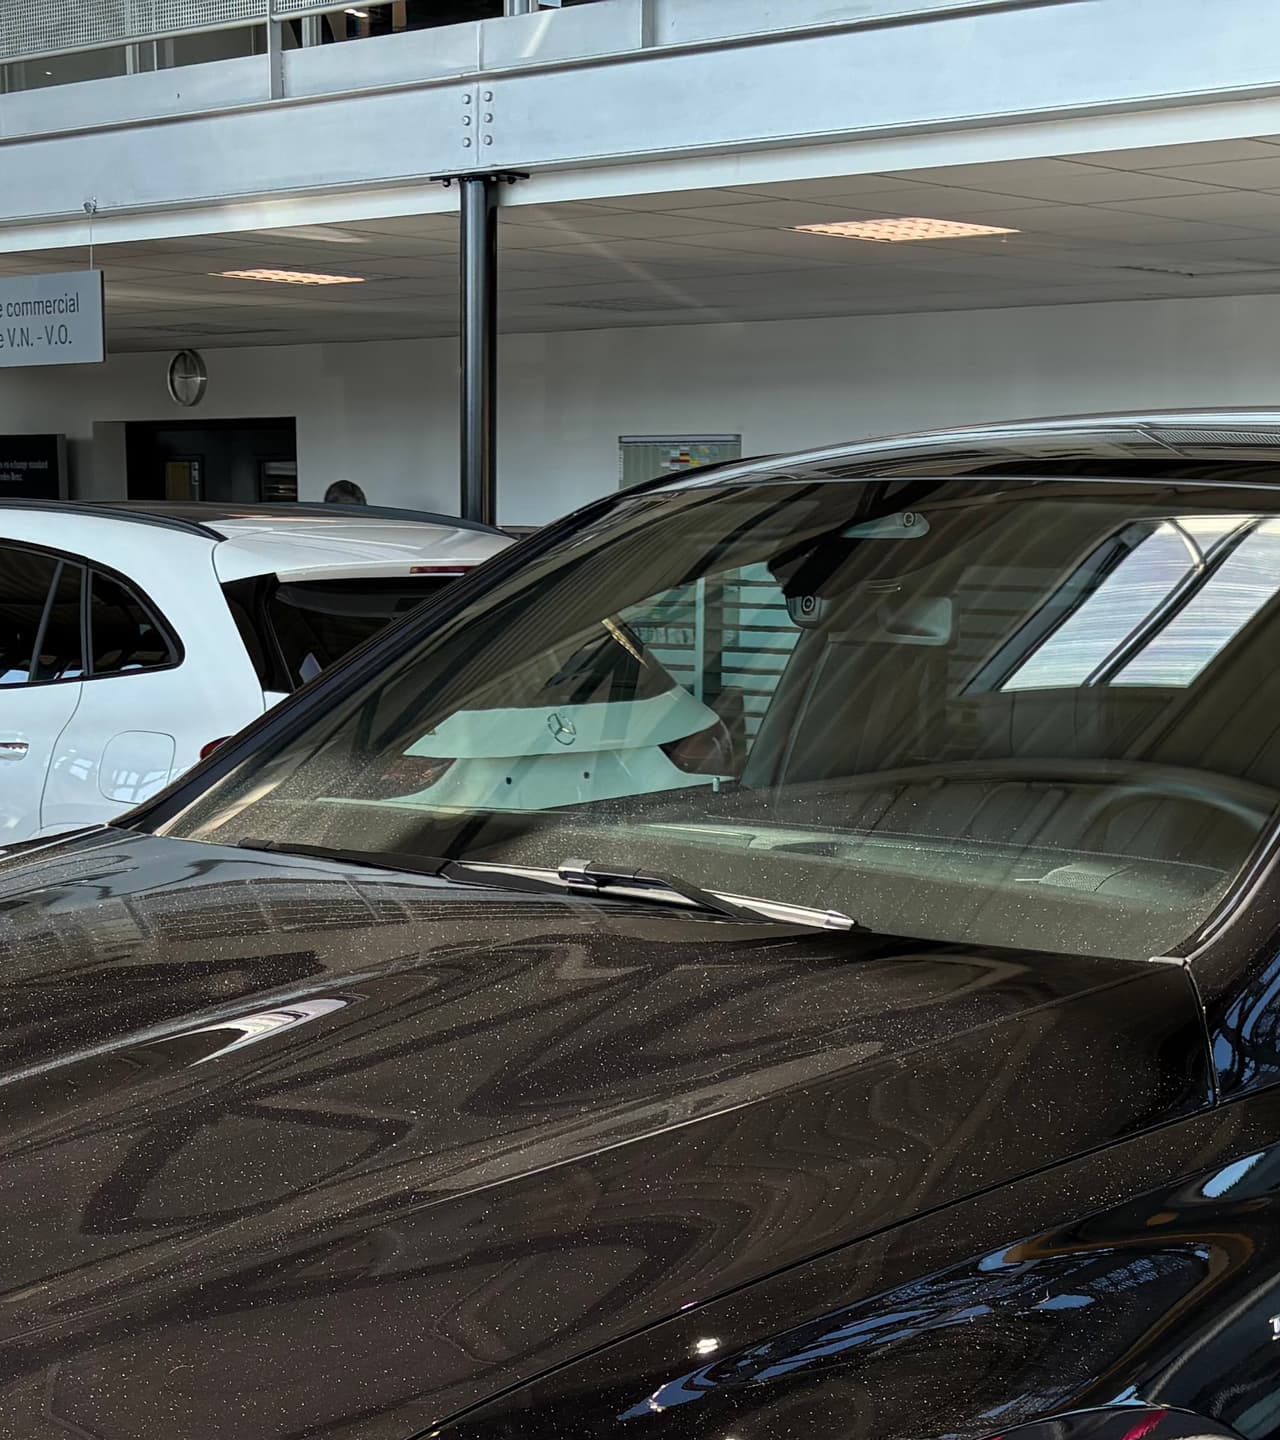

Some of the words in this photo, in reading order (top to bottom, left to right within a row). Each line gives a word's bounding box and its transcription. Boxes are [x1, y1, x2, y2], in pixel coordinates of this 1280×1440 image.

[6, 292, 80, 318] commercial
[7, 327, 34, 348] V.N.
[44, 324, 73, 345] V.O.
